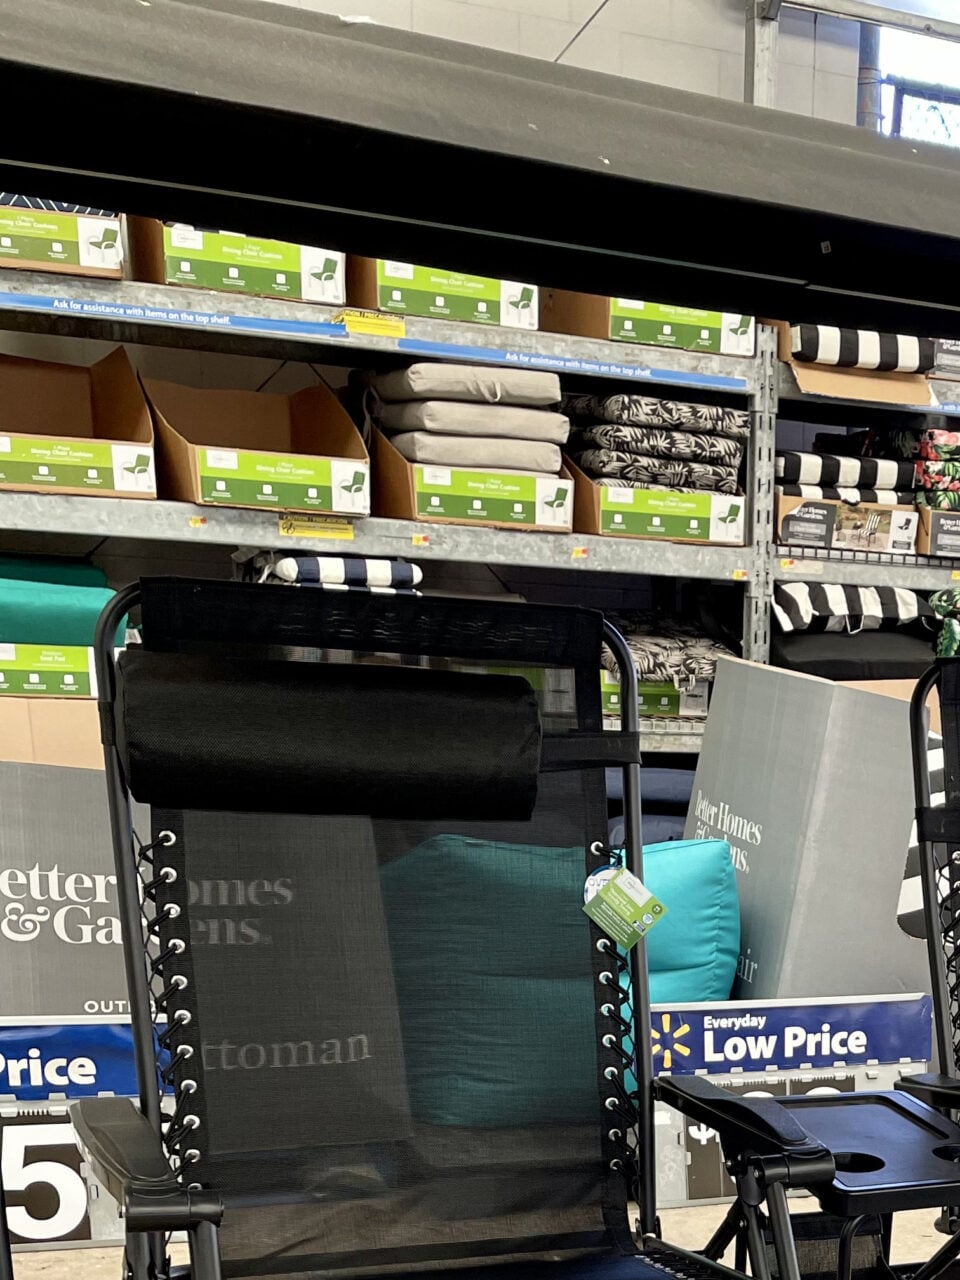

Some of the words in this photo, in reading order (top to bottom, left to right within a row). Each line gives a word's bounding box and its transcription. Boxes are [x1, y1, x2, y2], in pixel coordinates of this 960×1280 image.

[53, 300, 68, 309] Ask
[70, 301, 81, 310] for
[83, 303, 124, 314] assistance
[126, 307, 143, 316] with
[145, 309, 167, 318] items
[180, 312, 193, 321] the
[196, 315, 209, 324] top
[506, 352, 518, 361] Ask
[520, 353, 529, 362] for
[530, 355, 564, 366] assistance
[565, 359, 580, 368] with
[581, 361, 599, 371] items
[610, 364, 621, 373] the
[622, 366, 633, 376] top
[717, 802, 763, 846] Homes
[0, 862, 117, 903] etter
[738, 948, 757, 983] air
[703, 1013, 767, 1031] Everyday
[201, 1034, 372, 1071] ttoman
[704, 1030, 777, 1063] Low
[784, 1023, 868, 1058] Price
[2, 1123, 88, 1240] 5
